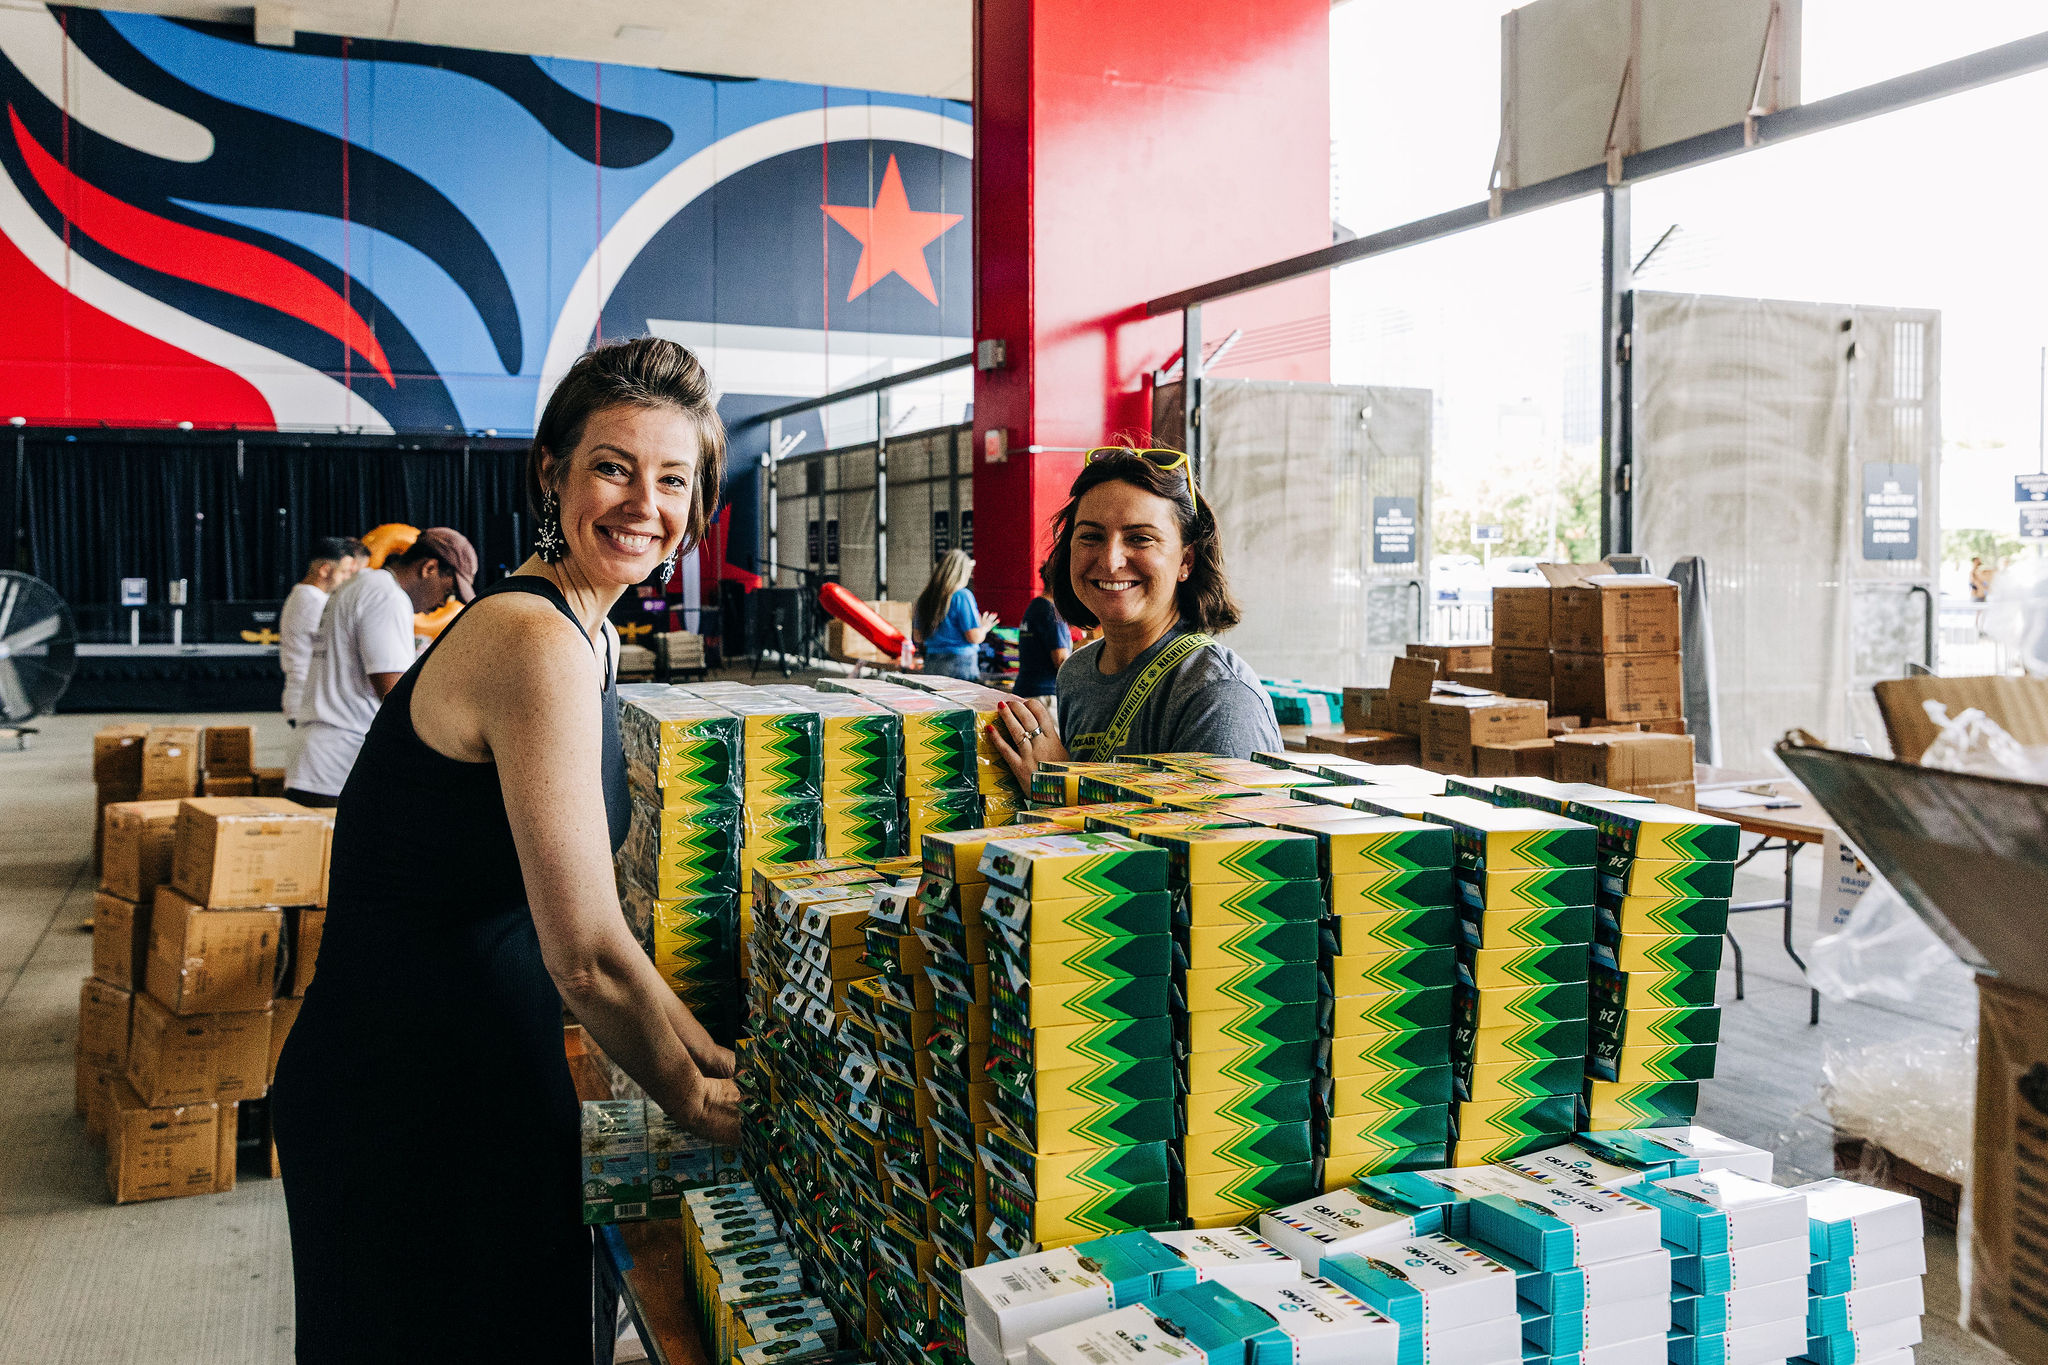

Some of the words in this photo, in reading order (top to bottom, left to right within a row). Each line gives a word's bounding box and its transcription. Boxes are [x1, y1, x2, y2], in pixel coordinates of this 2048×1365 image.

[1156, 638, 1194, 669] NASHVILLE
[1194, 634, 1206, 644] SC
[1115, 689, 1142, 729] NASHVILLE
[1137, 679, 1149, 695] SC
[1608, 854, 1629, 868] 24
[1598, 1008, 1616, 1023] 24
[1456, 1027, 1471, 1042] 24
[950, 1043, 963, 1056] 24
[1597, 1041, 1614, 1056] 24
[1014, 1071, 1028, 1087] 24
[909, 1151, 918, 1165] 24
[1545, 1156, 1598, 1180] CRAYONS
[1547, 1188, 1604, 1213] CRAYONS
[957, 1201, 969, 1217] 24
[1313, 1205, 1364, 1229] CRAYONS
[1195, 1235, 1240, 1260] CRAYONS
[1402, 1245, 1458, 1275] CRAYONS
[887, 1285, 895, 1301] 24
[1278, 1289, 1334, 1323] CRAYONS
[915, 1319, 925, 1335] 24
